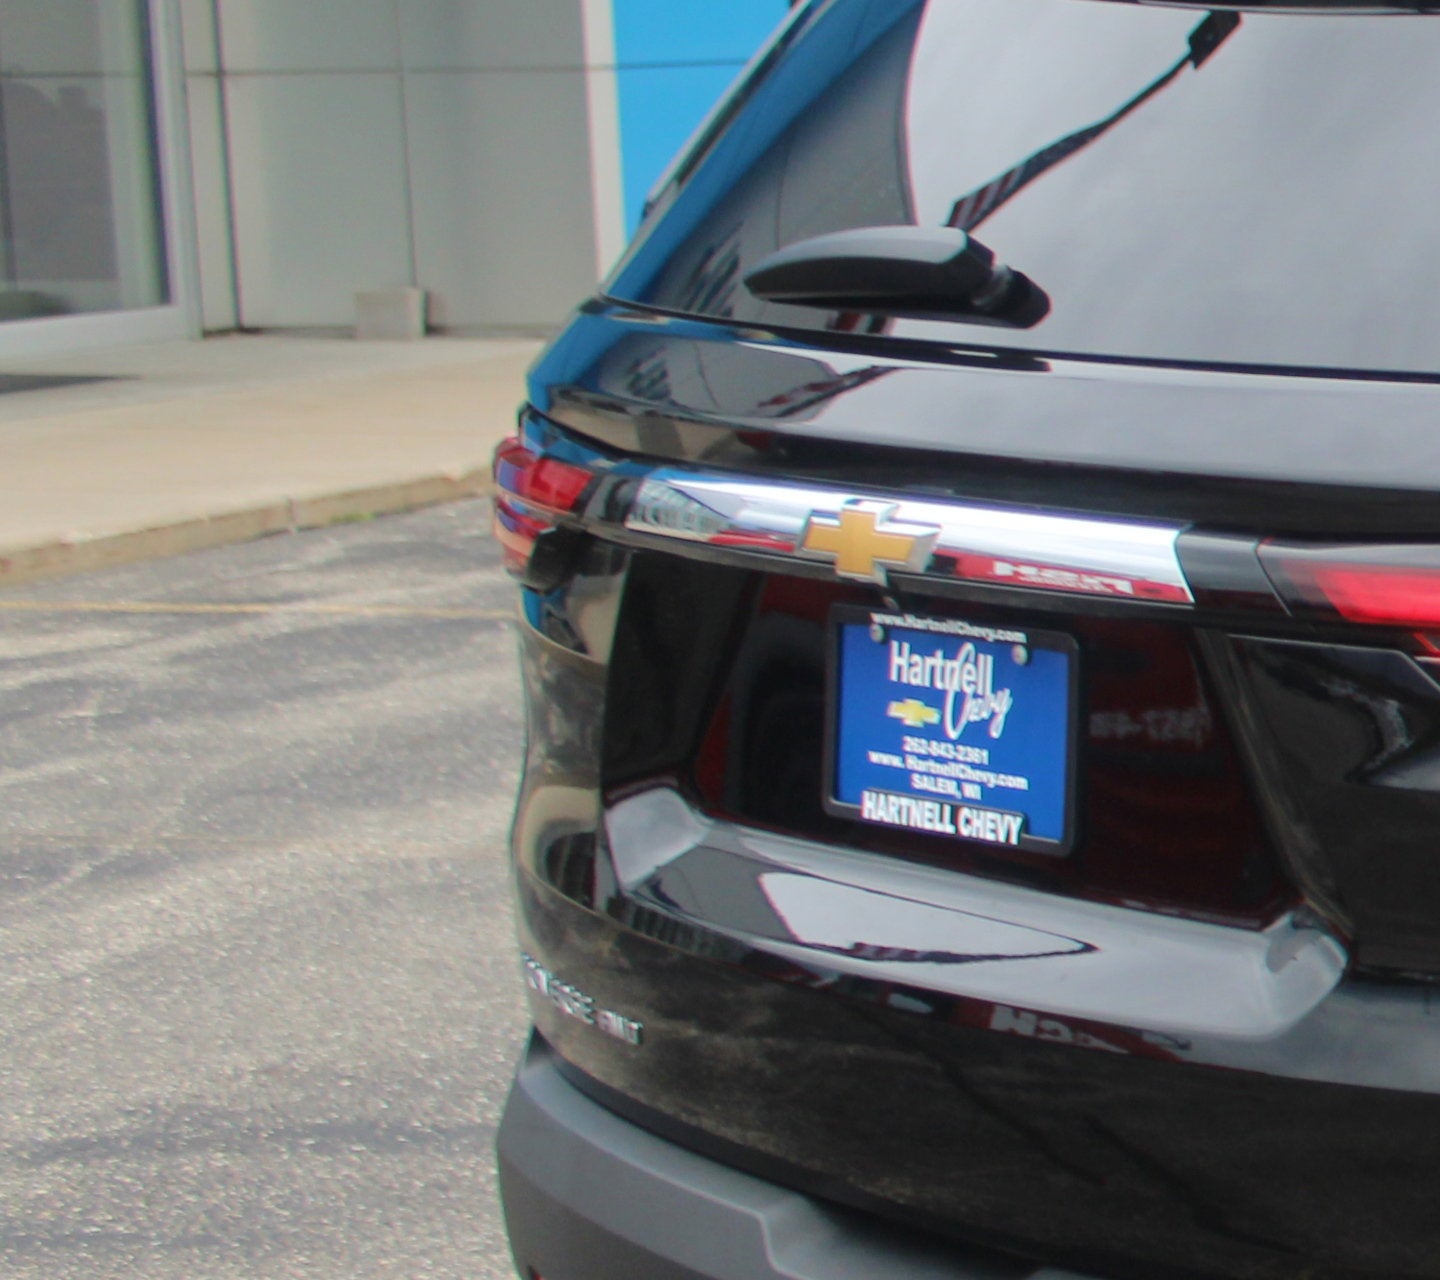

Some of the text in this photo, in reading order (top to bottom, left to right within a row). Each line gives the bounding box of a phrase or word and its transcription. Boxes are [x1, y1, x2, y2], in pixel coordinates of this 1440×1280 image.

[889, 639, 994, 694] Hartnell
[861, 790, 1024, 845] HARTNELL CHEVY
